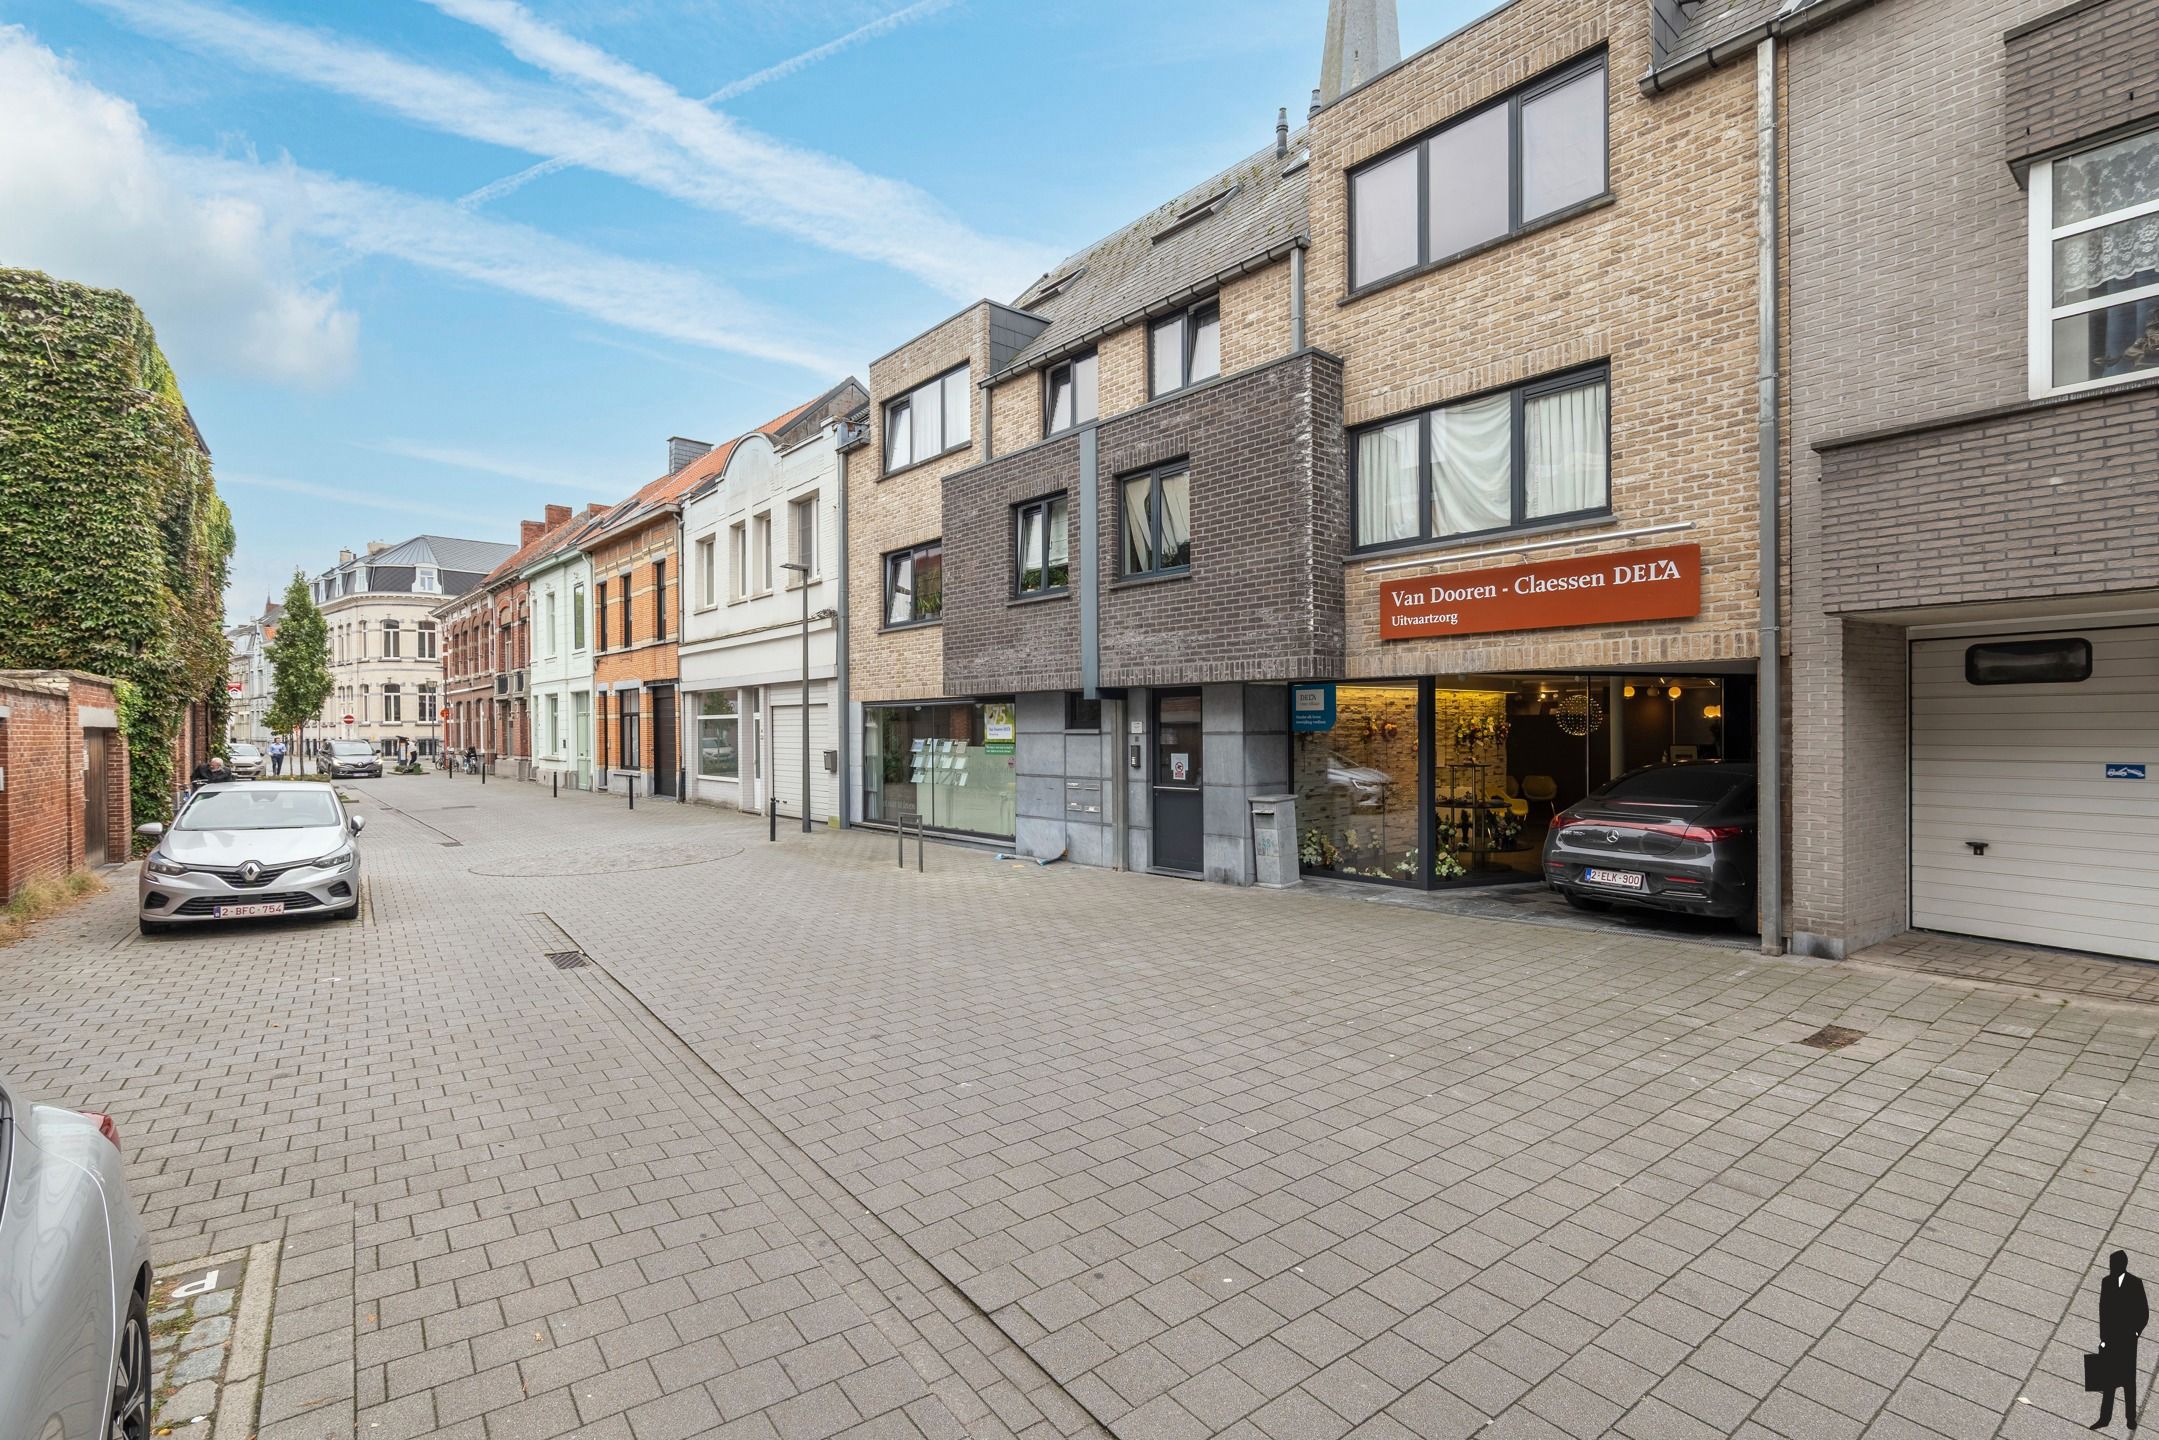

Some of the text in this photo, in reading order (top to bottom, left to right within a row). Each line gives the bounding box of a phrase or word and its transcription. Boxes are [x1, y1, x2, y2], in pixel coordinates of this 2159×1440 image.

[1391, 589, 1425, 608] Van
[1430, 584, 1497, 605] Dooren
[1514, 571, 1606, 595] Claessen
[1612, 559, 1681, 585] DELA
[1391, 611, 1458, 628] Uitvaartzorg
